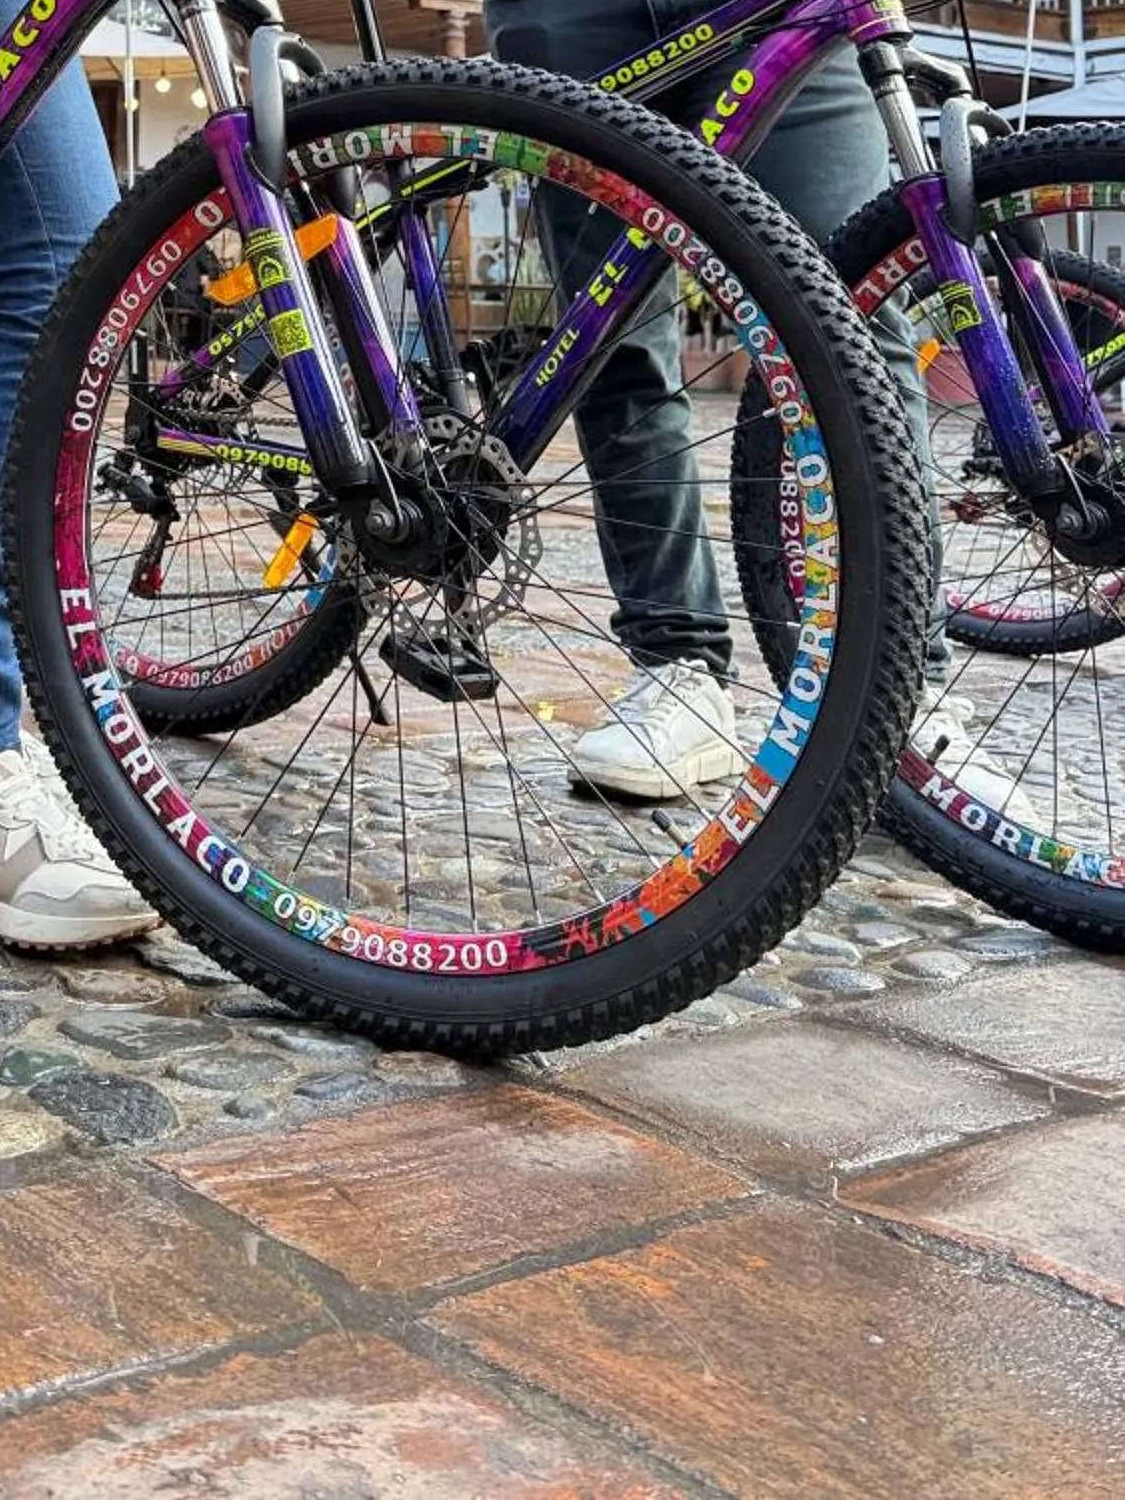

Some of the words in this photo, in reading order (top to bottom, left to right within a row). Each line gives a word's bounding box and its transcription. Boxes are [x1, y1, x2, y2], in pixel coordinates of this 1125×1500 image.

[599, 23, 715, 93] 9088200
[440, 126, 496, 157] EL
[588, 261, 629, 307] EL
[642, 207, 804, 424] 0979088200
[70, 239, 182, 432] 0979088200
[535, 327, 580, 388] HOTEL
[216, 444, 312, 475] 0979088
[722, 781, 781, 844] EL
[767, 453, 839, 758] MORLACO
[60, 589, 97, 649] EL
[83, 669, 251, 894] MORLACO
[921, 774, 1125, 888] MORLAC
[273, 891, 508, 973] 0979088200
